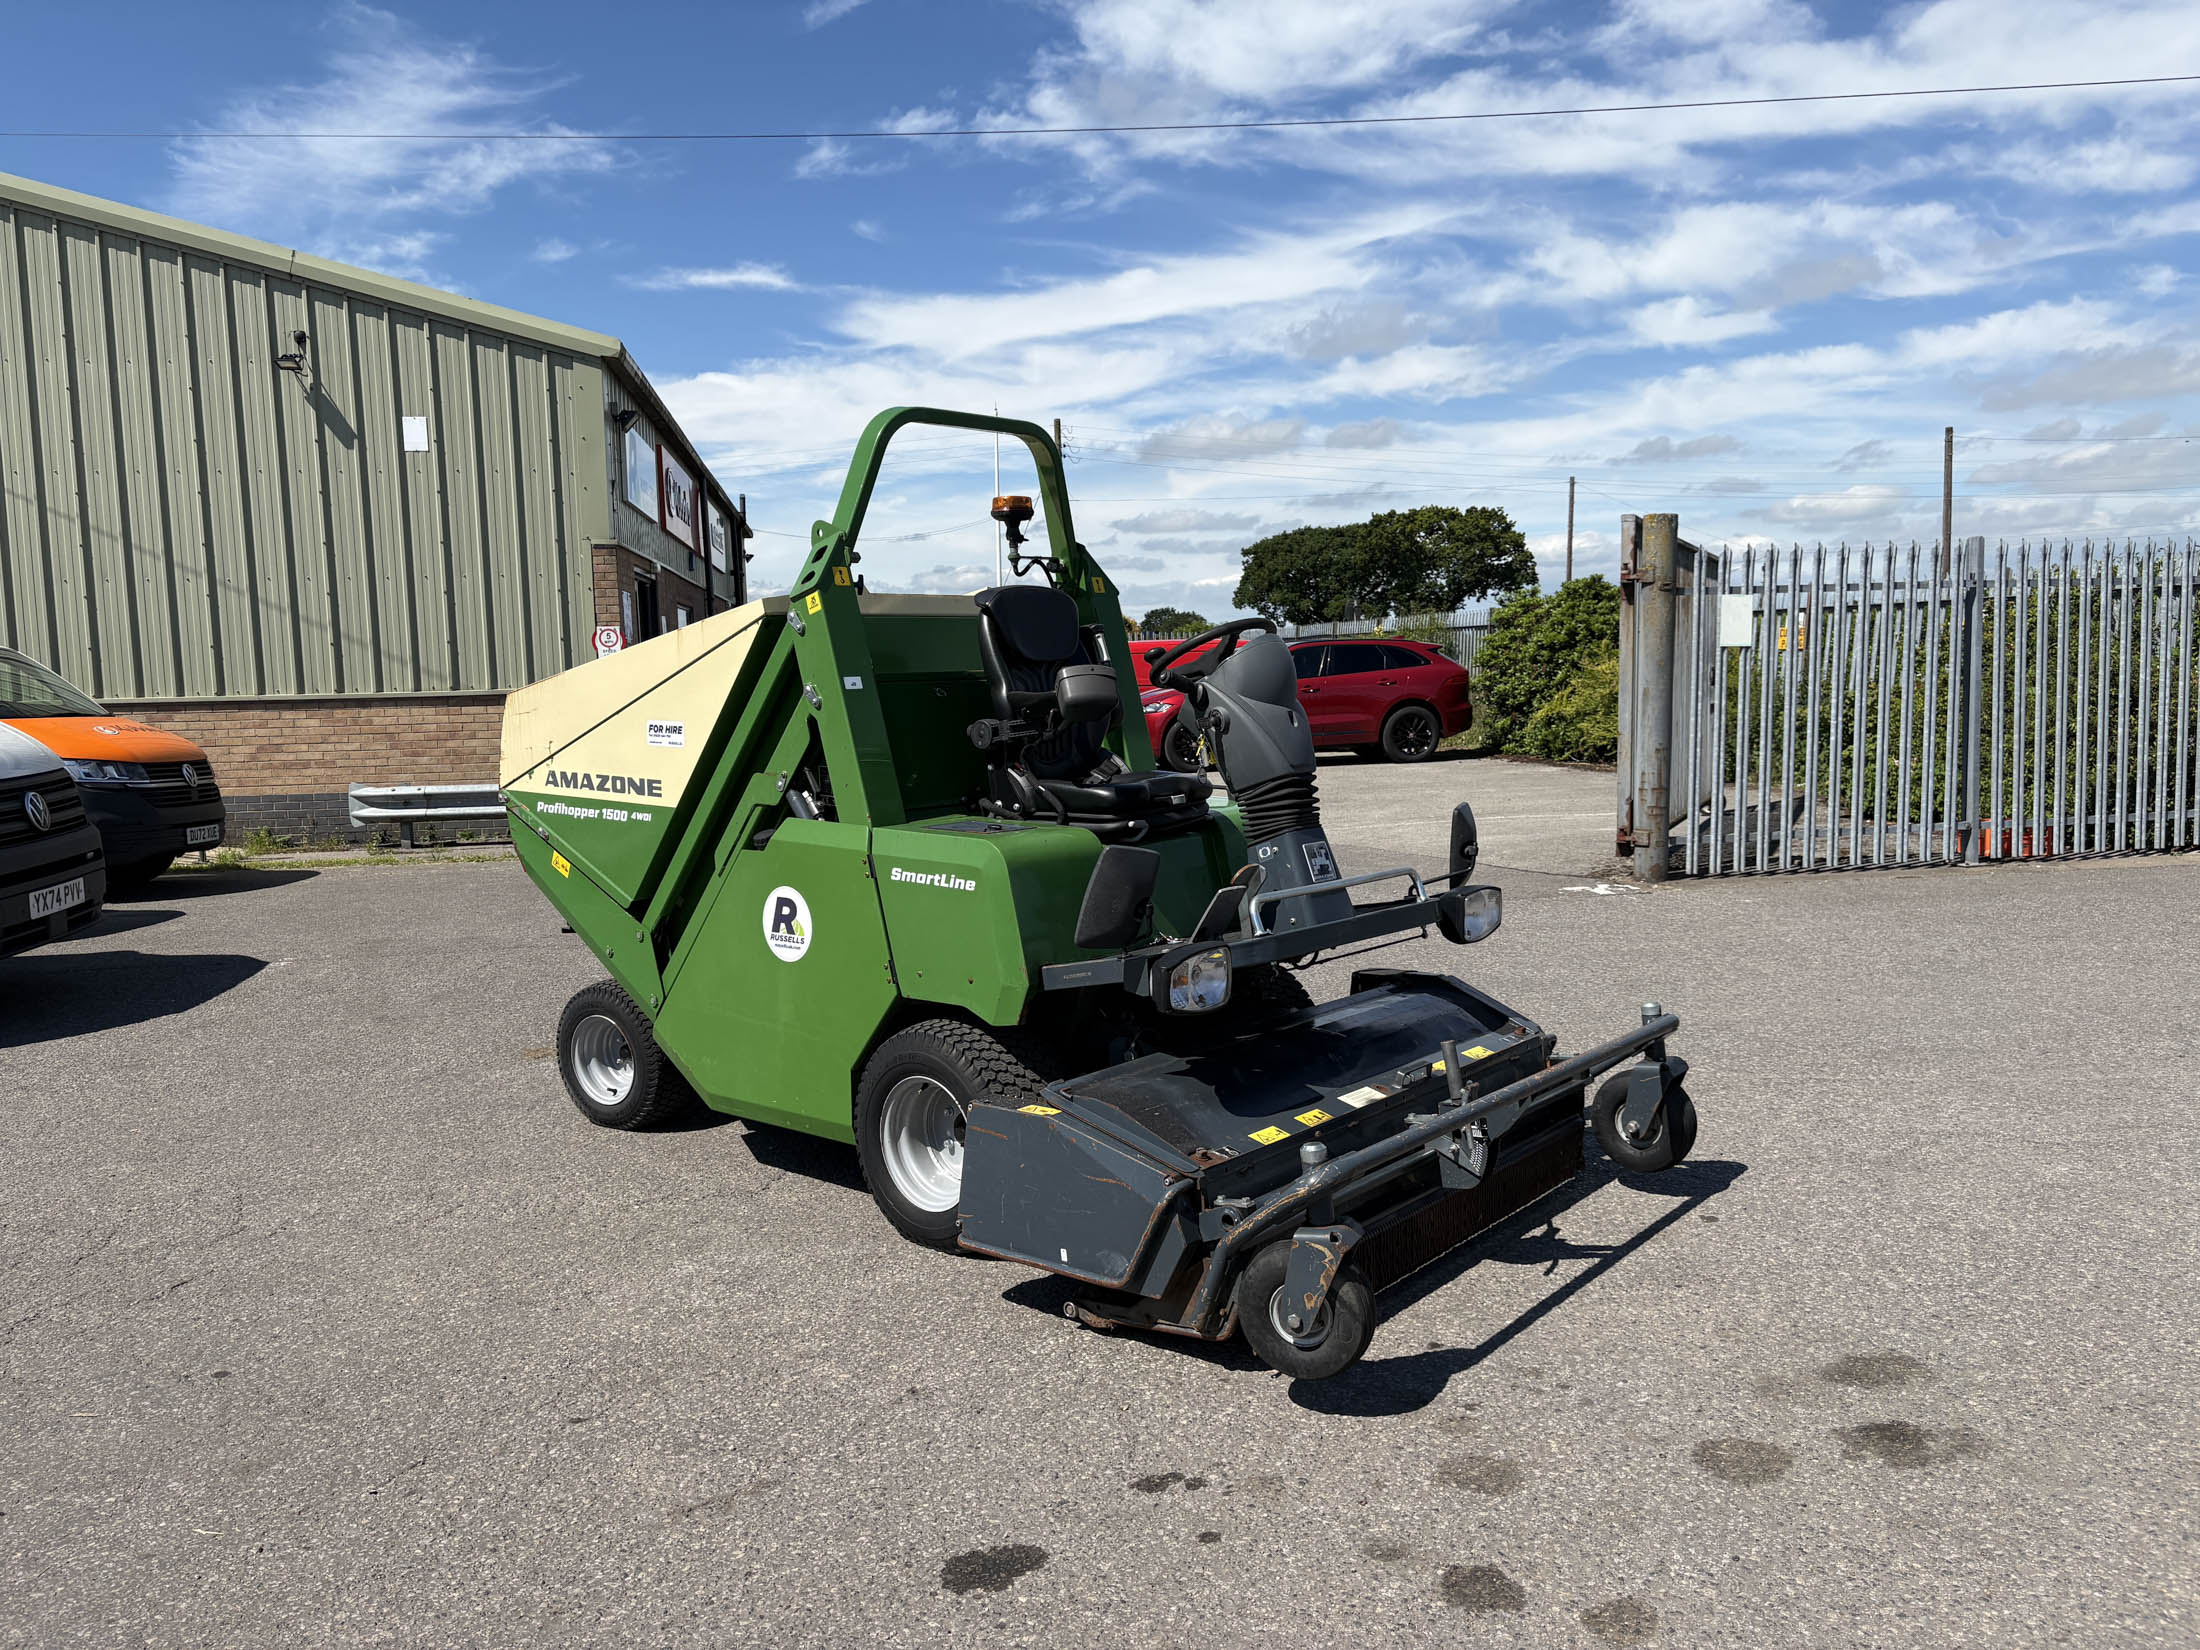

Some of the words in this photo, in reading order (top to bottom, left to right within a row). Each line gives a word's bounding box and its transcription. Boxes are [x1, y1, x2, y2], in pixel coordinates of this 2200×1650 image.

[606, 632, 611, 640] 5
[649, 724, 663, 733] FOR
[665, 725, 683, 735] HIRE
[545, 770, 662, 797] AMAZONE
[537, 801, 600, 819] Profihopper
[602, 808, 627, 821] 1500
[891, 867, 976, 891] SmartLine
[34, 888, 61, 912] YX74
[772, 896, 797, 935] R
[770, 933, 805, 944] RUSSELLS
